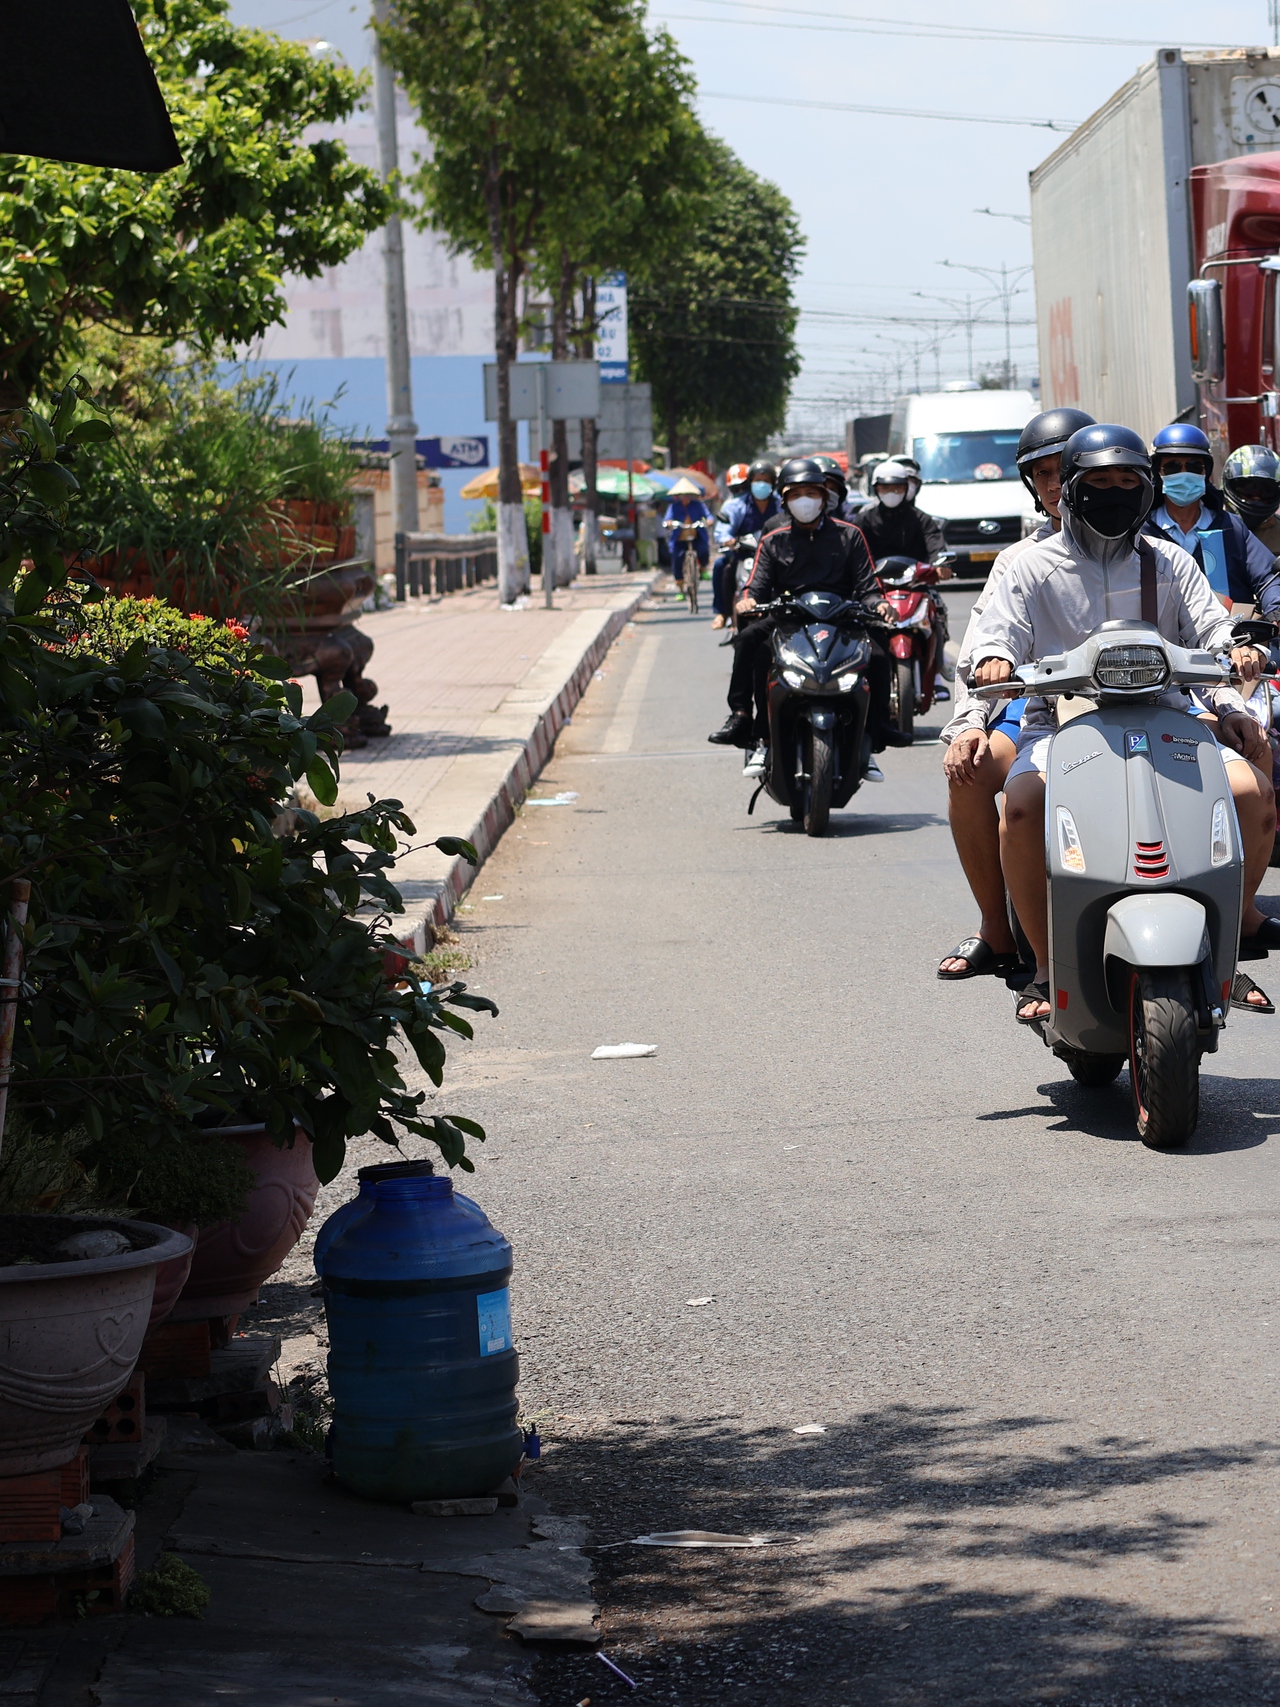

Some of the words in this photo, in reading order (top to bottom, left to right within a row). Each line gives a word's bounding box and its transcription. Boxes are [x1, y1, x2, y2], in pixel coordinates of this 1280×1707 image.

[450, 442, 479, 454] ATM
[1130, 736, 1140, 747] P
[1061, 750, 1104, 774] Vespa
